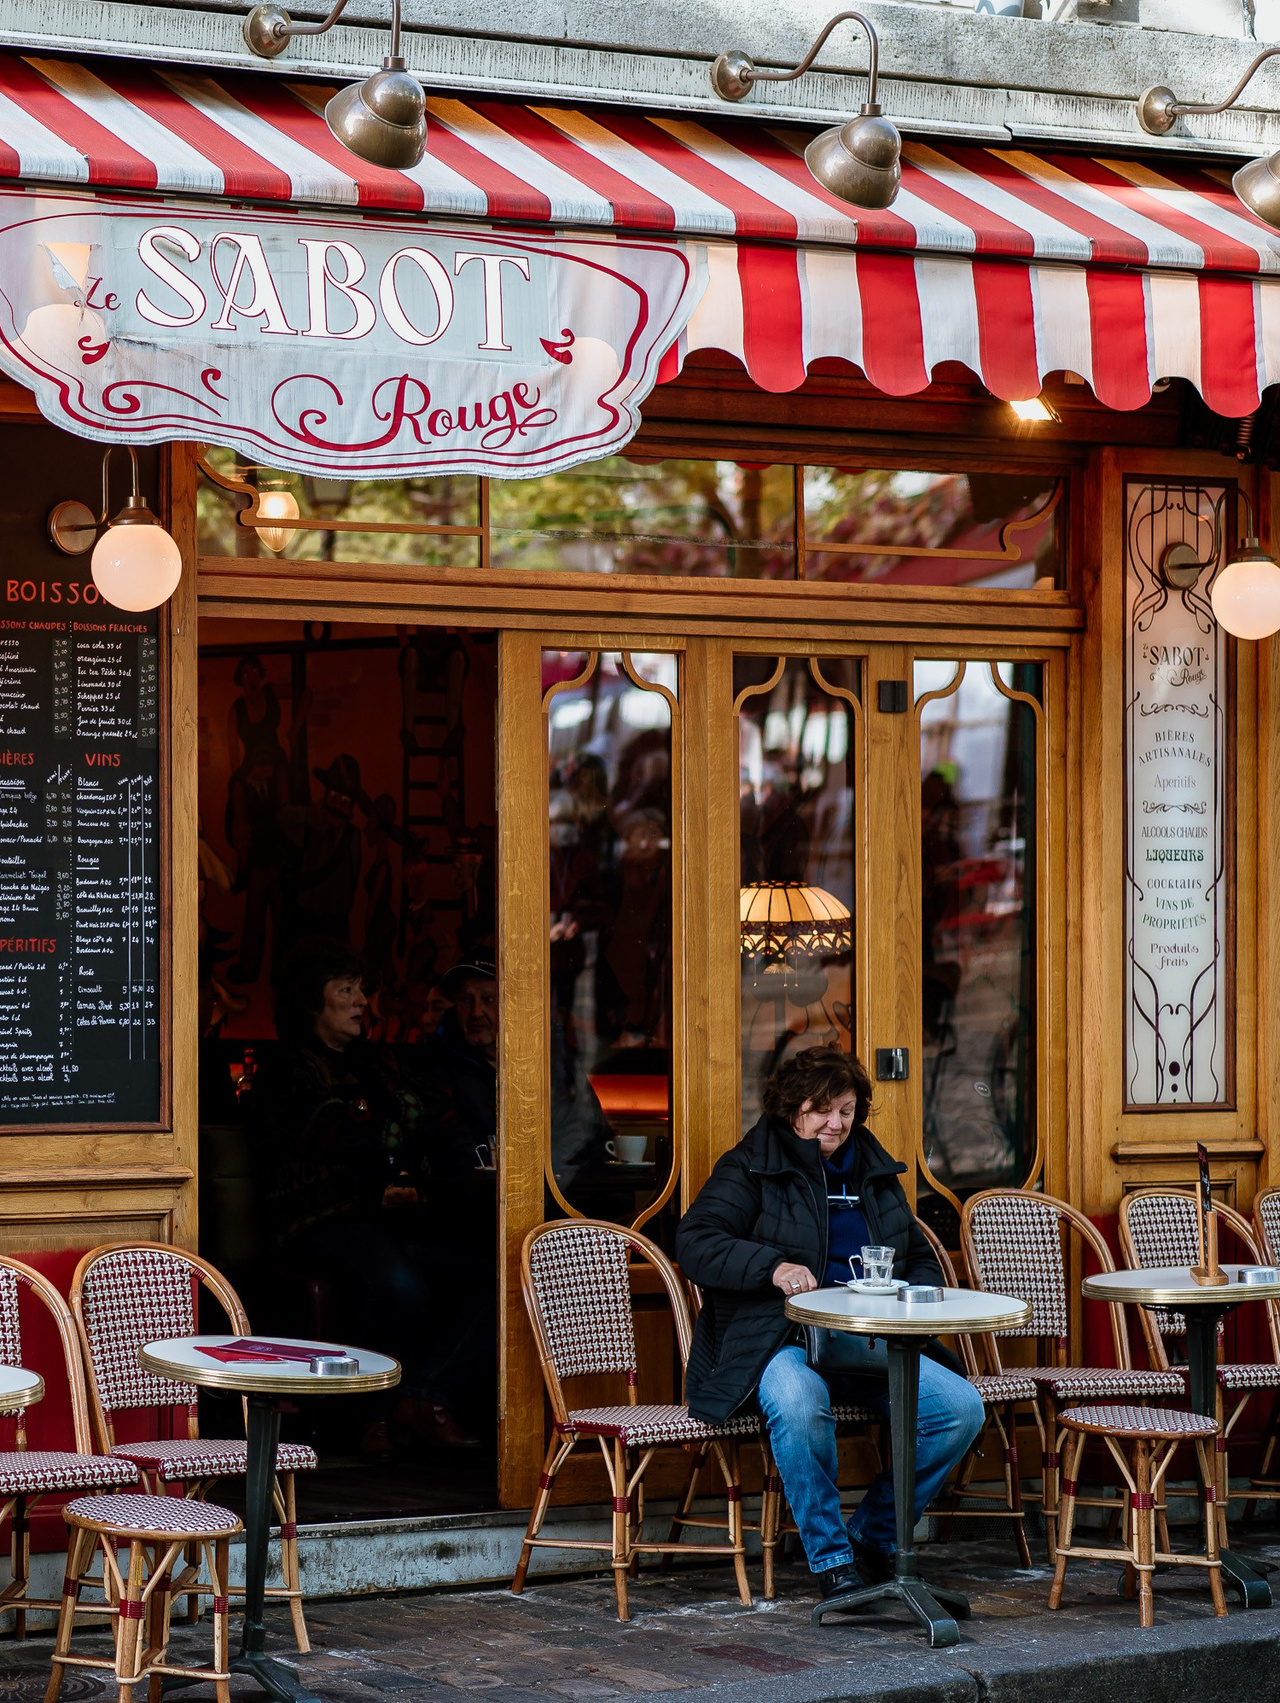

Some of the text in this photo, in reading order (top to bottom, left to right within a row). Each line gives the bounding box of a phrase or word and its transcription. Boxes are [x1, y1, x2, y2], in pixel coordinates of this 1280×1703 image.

[136, 225, 532, 353] SABOT
[360, 372, 558, 450] Rouge
[7, 579, 107, 605] BOISSO
[73, 621, 107, 632] BOISSONS
[1149, 645, 1205, 667] SABOT
[1178, 668, 1208, 685] Rouge
[1154, 729, 1195, 744] BIÈRES
[85, 753, 122, 768] VINS
[1138, 747, 1213, 768] ARTISANALES
[1141, 826, 1208, 839] ALCOOLS CHAUDS
[1145, 849, 1204, 863] LIQUEURS
[1155, 896, 1194, 911] VINS DE
[1142, 913, 1207, 930] PROPRIÉTÉS
[1150, 943, 1199, 954] Produits
